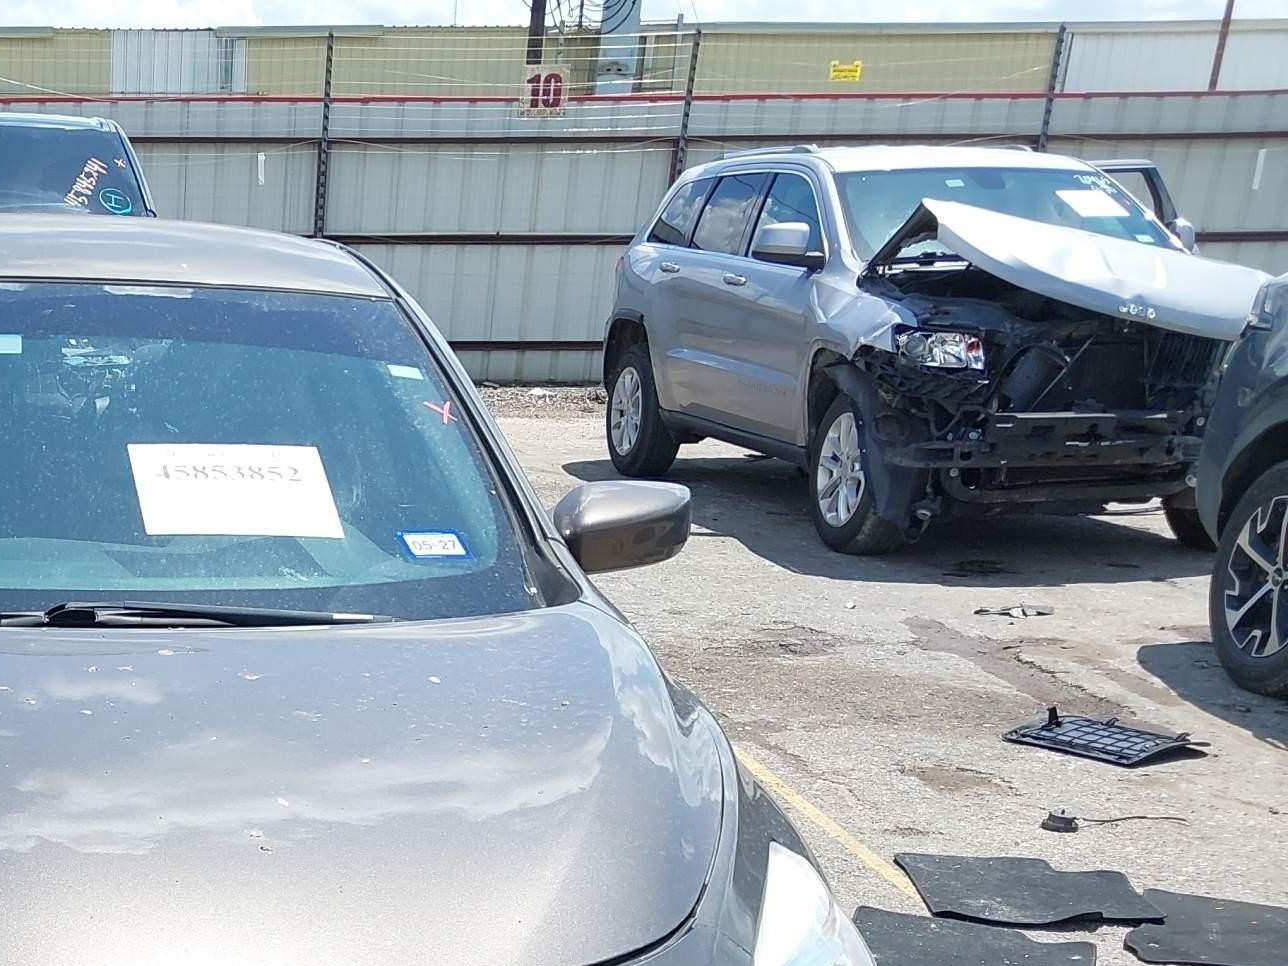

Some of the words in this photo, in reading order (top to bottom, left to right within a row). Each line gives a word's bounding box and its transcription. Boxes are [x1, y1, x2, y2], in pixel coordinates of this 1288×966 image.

[526, 72, 563, 109] 10
[154, 464, 303, 482] 45853852
[412, 540, 457, 551] 05-27
